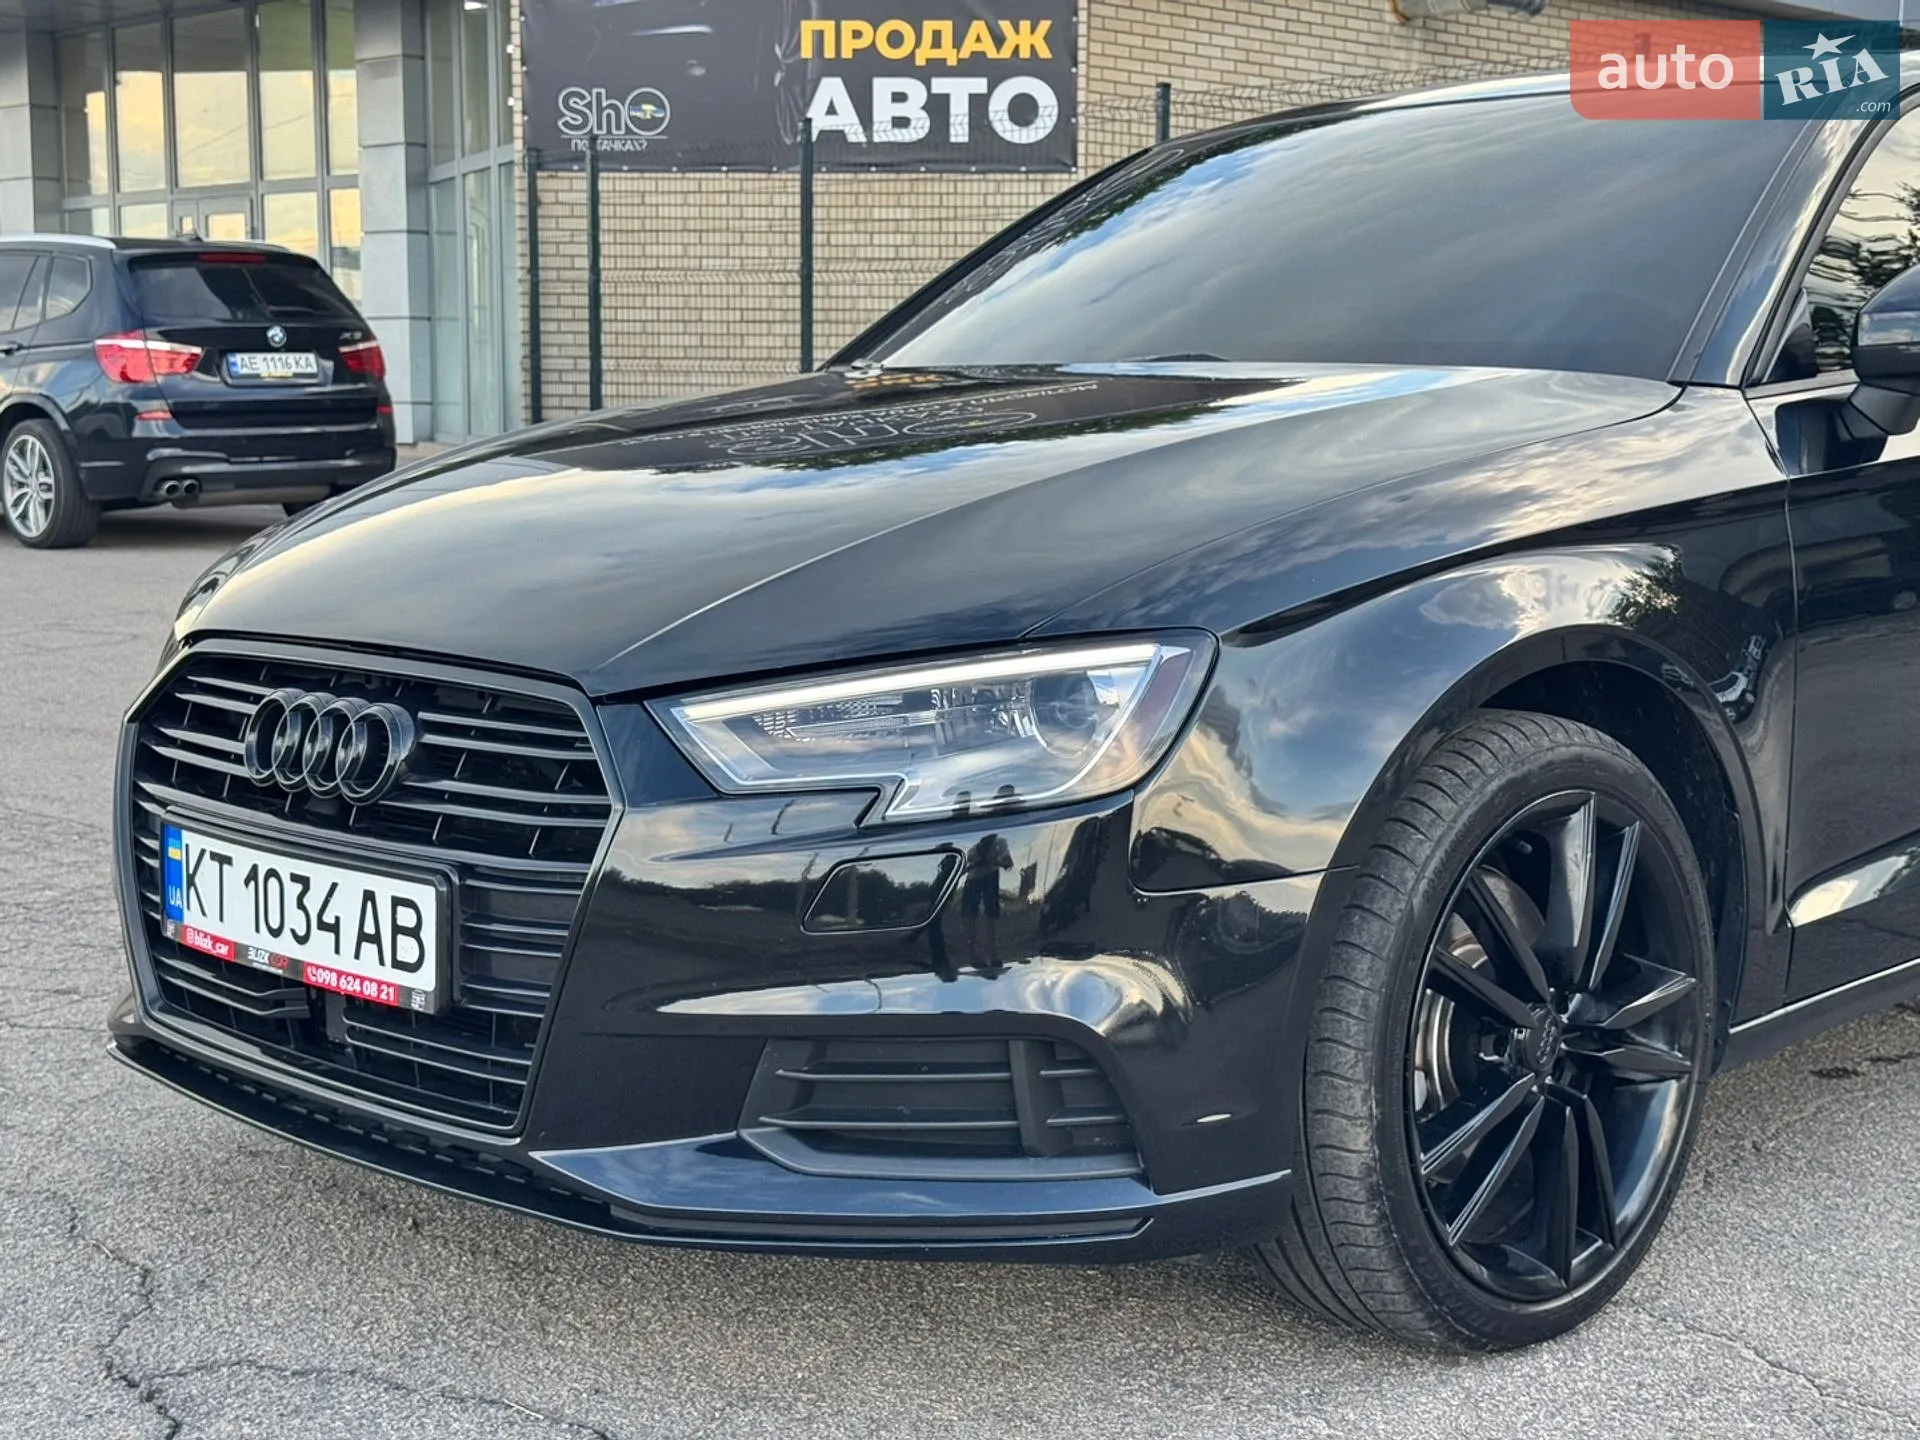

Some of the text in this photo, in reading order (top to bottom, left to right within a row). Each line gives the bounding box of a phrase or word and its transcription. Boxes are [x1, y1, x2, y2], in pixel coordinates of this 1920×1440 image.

[801, 19, 1053, 66] ПРОДАЖ
[807, 75, 1059, 145] АВТО
[240, 354, 314, 371] AE 1116 KA
[168, 884, 183, 909] UA
[184, 842, 425, 974] KT 1034 AB
[316, 967, 395, 1001] 098 624 08 21
